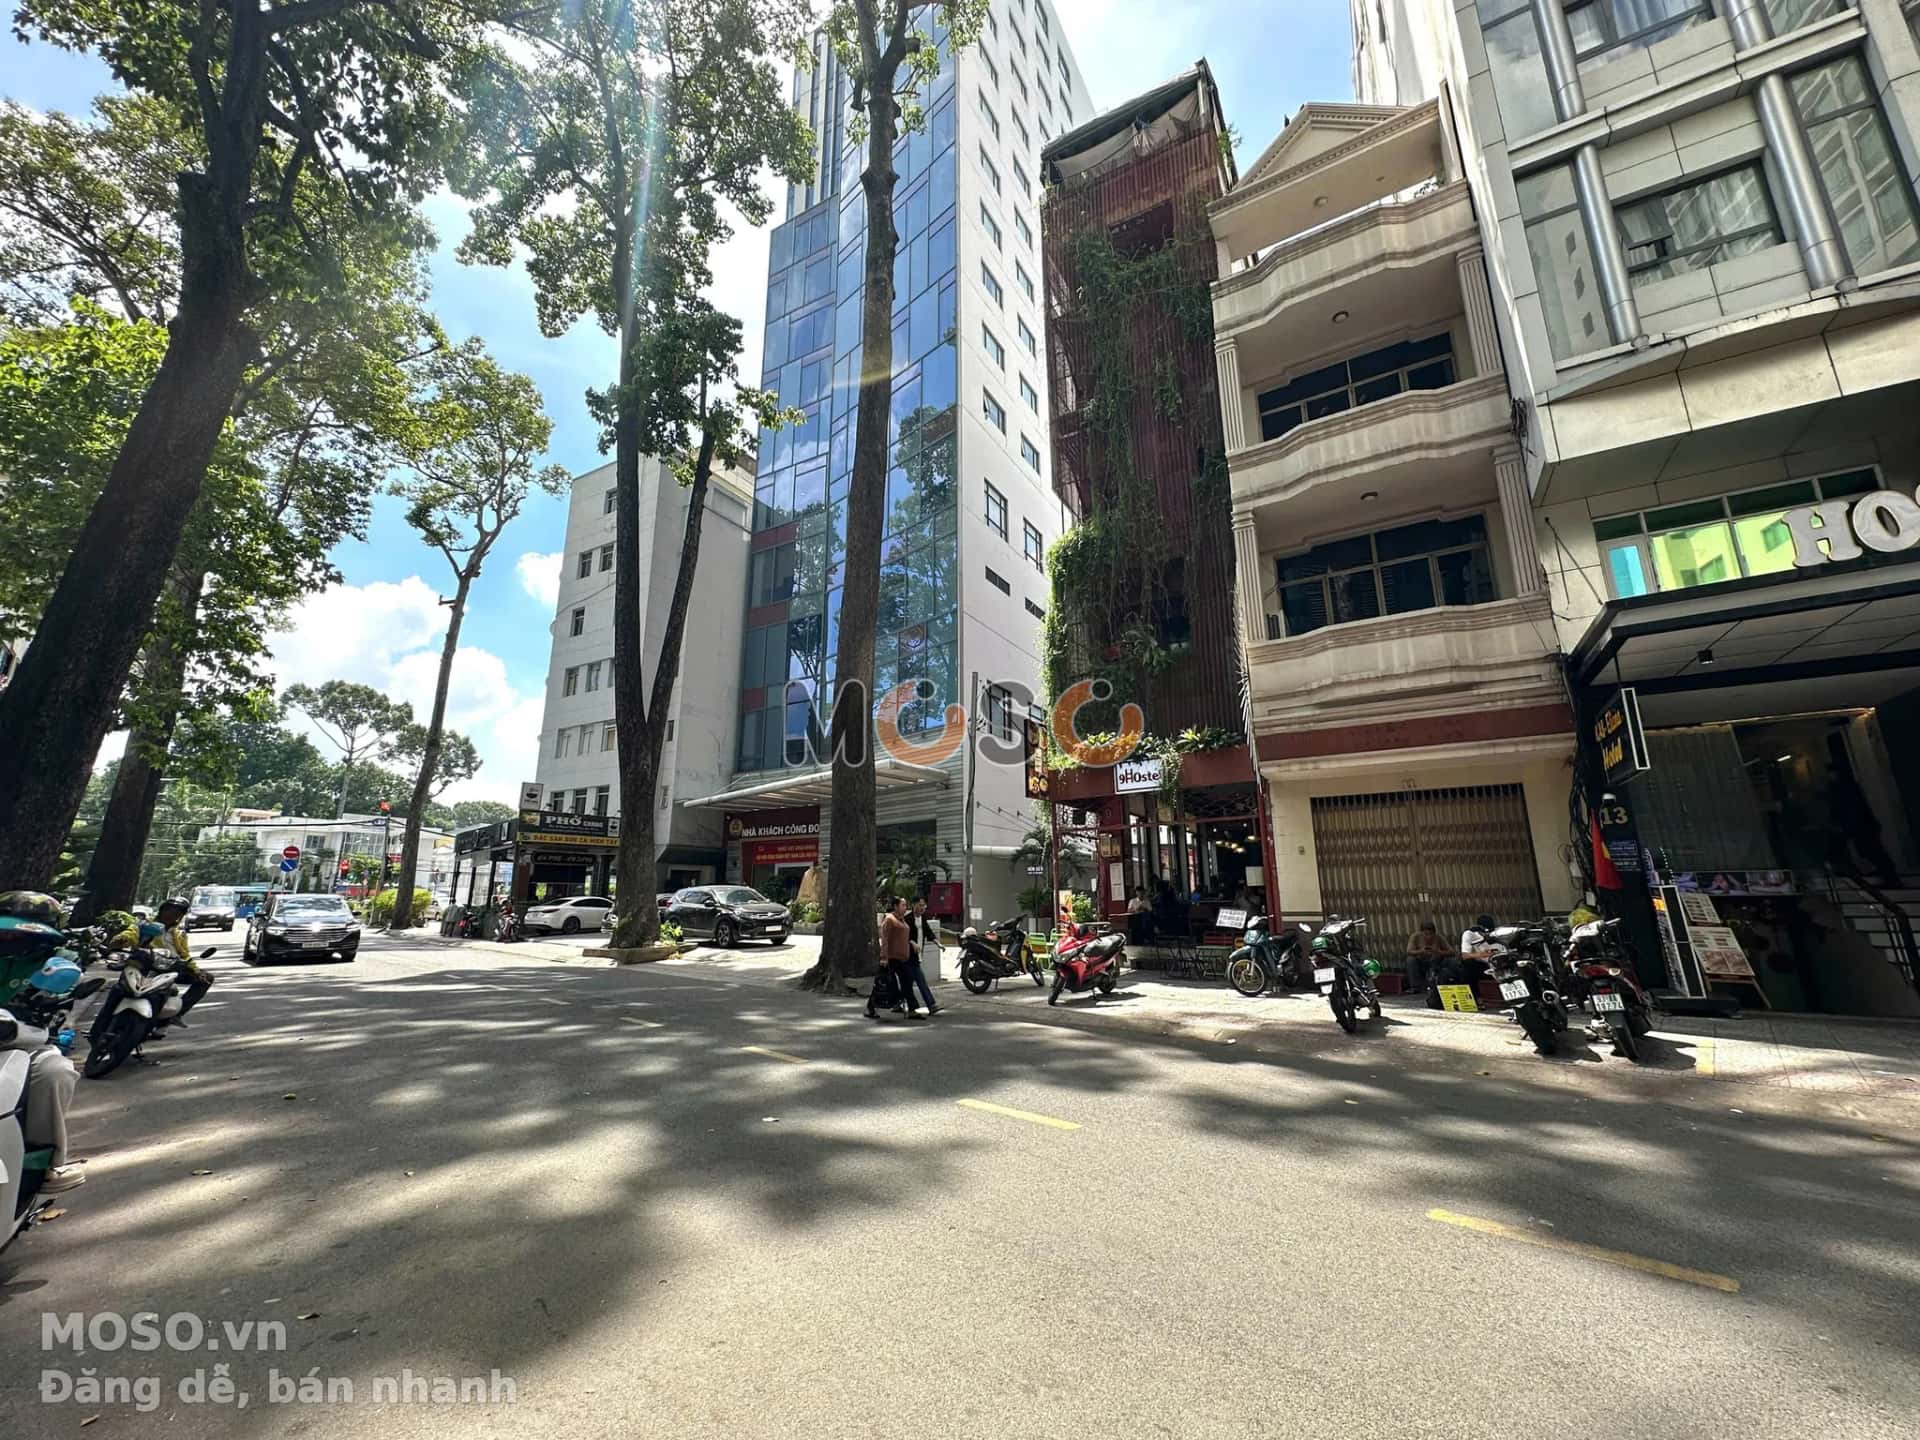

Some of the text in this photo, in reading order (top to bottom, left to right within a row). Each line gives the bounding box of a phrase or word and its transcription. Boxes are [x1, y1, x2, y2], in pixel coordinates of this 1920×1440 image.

[1782, 484, 1920, 567] HO
[1601, 806, 1628, 824] 13
[742, 825, 757, 837] NHÀ
[758, 823, 783, 836] KHÁCH
[785, 822, 807, 834] CÔNG
